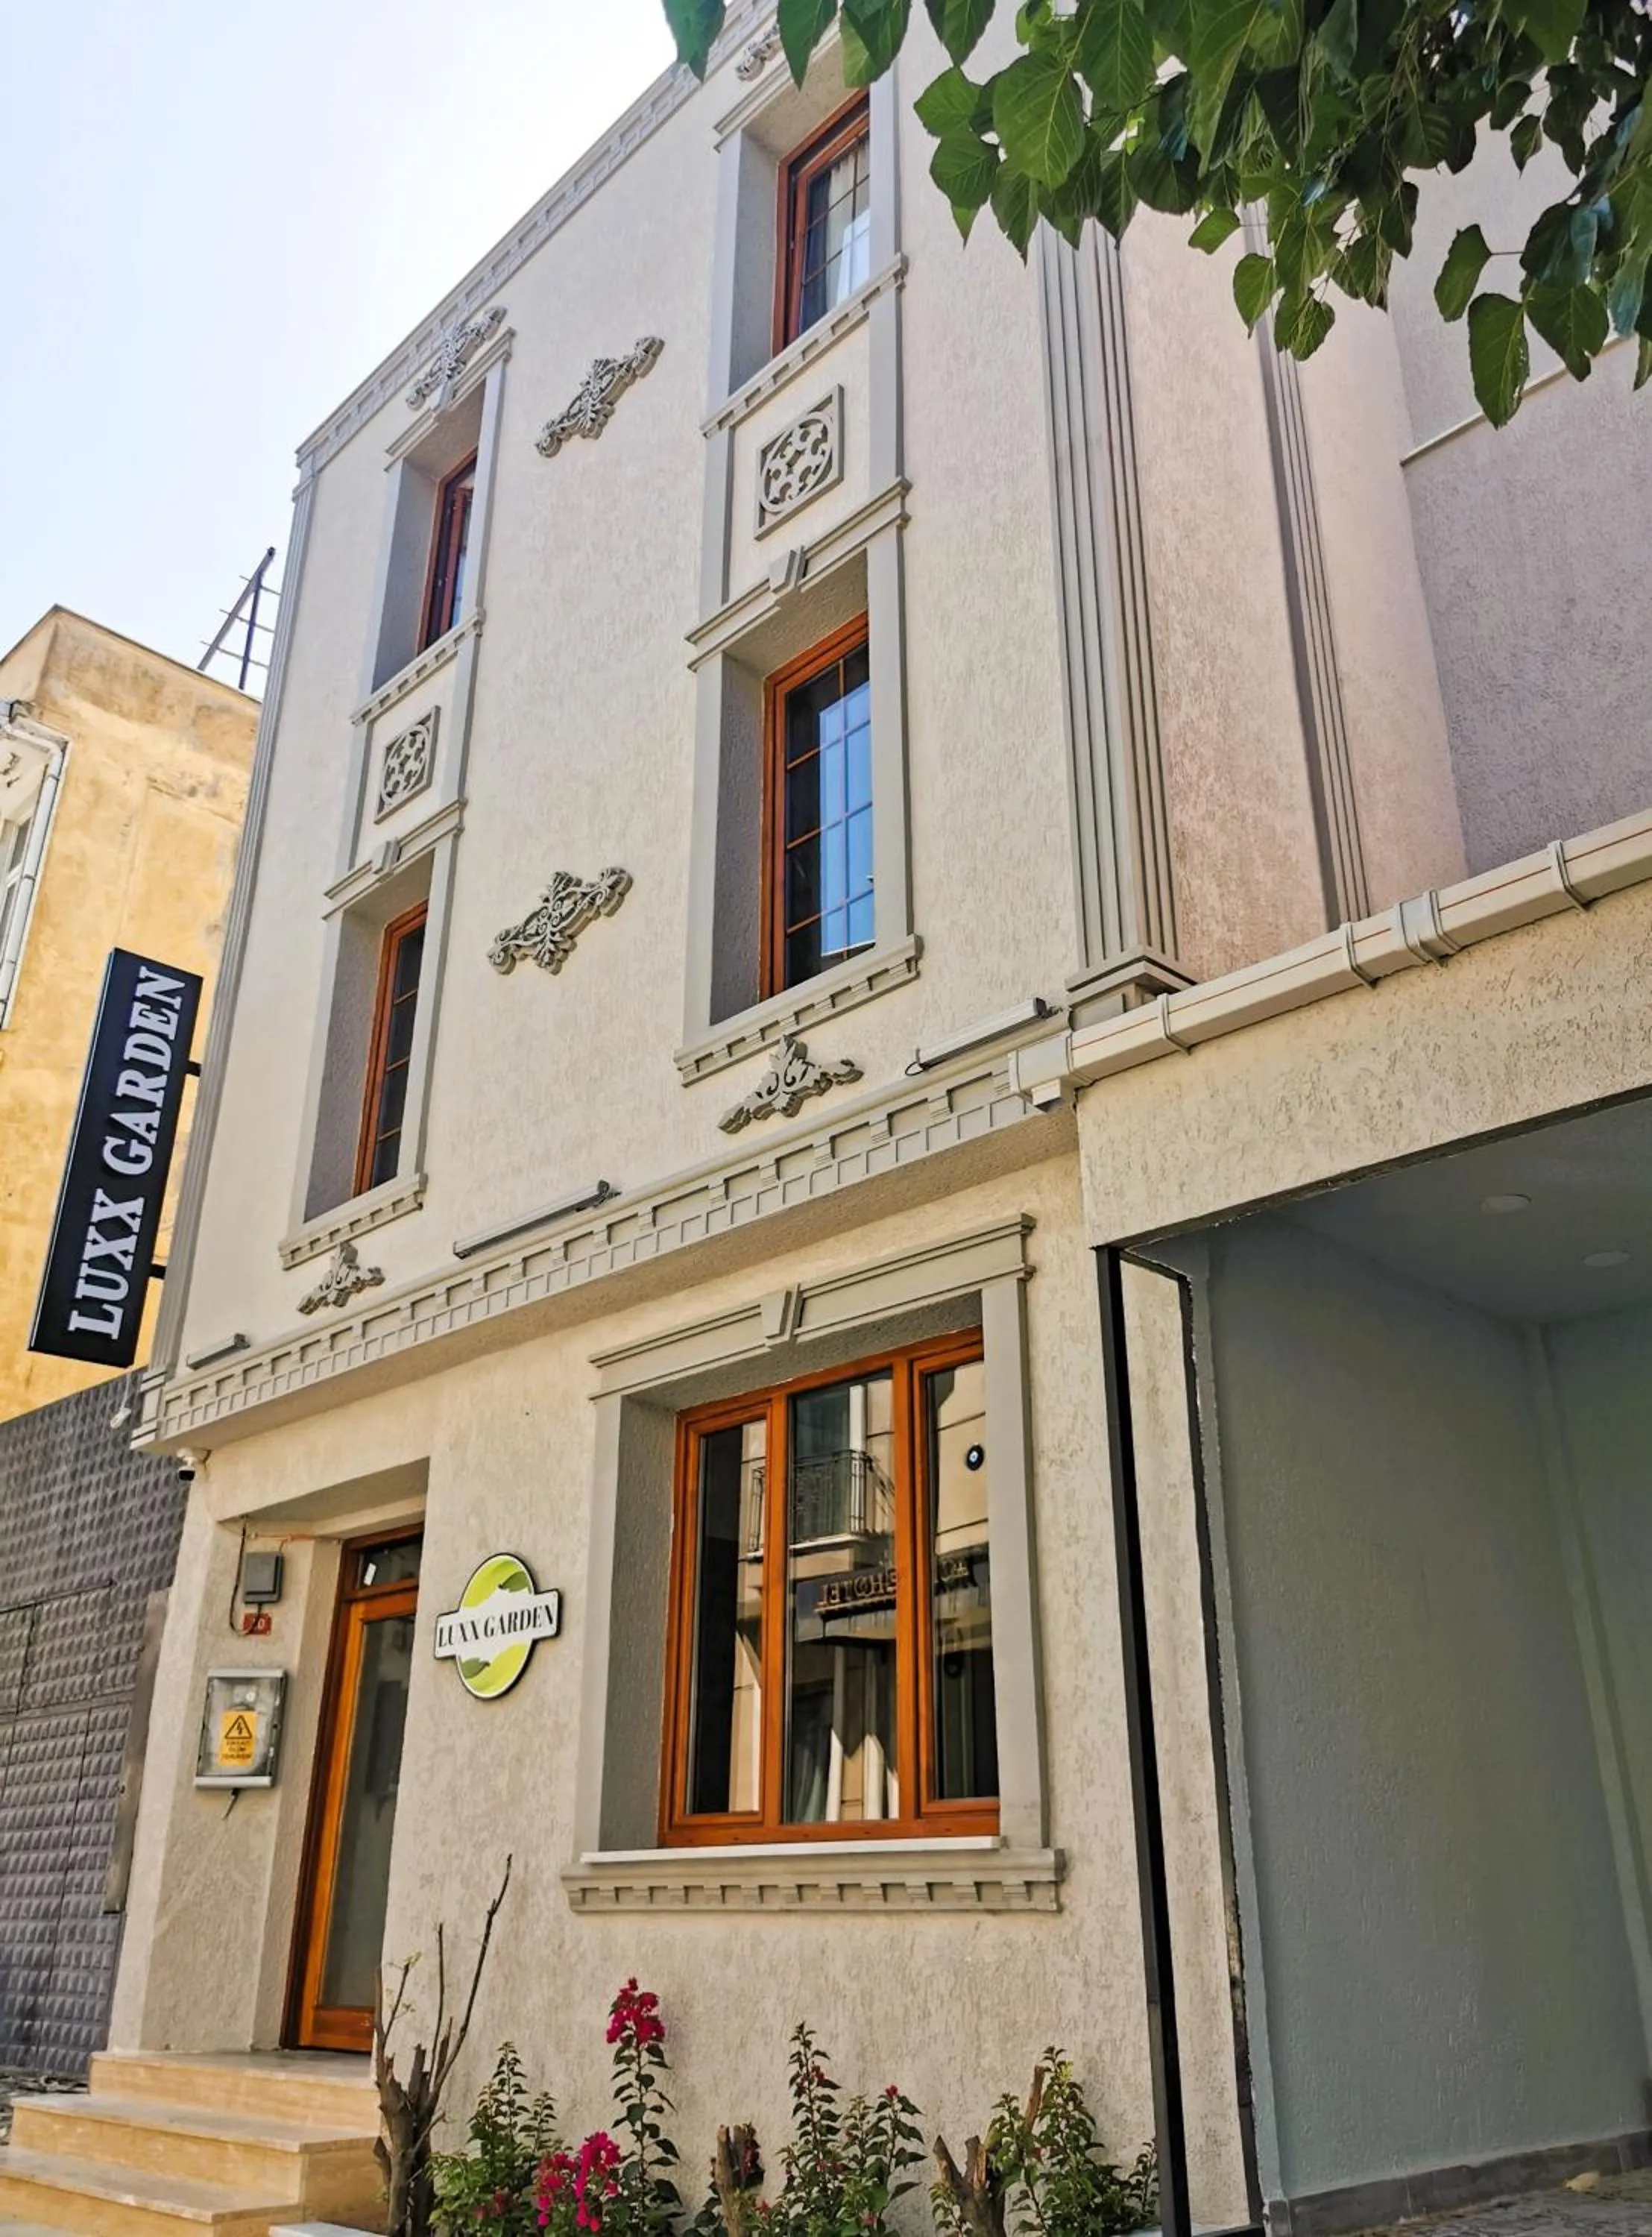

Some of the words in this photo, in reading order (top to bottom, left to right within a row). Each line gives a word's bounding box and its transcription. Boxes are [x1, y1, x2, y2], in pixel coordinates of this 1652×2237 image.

[101, 966, 186, 1176] GARDEN
[68, 1188, 145, 1340] LUXX
[438, 1618, 481, 1648] LUXX
[483, 1604, 554, 1638] GARDEN
